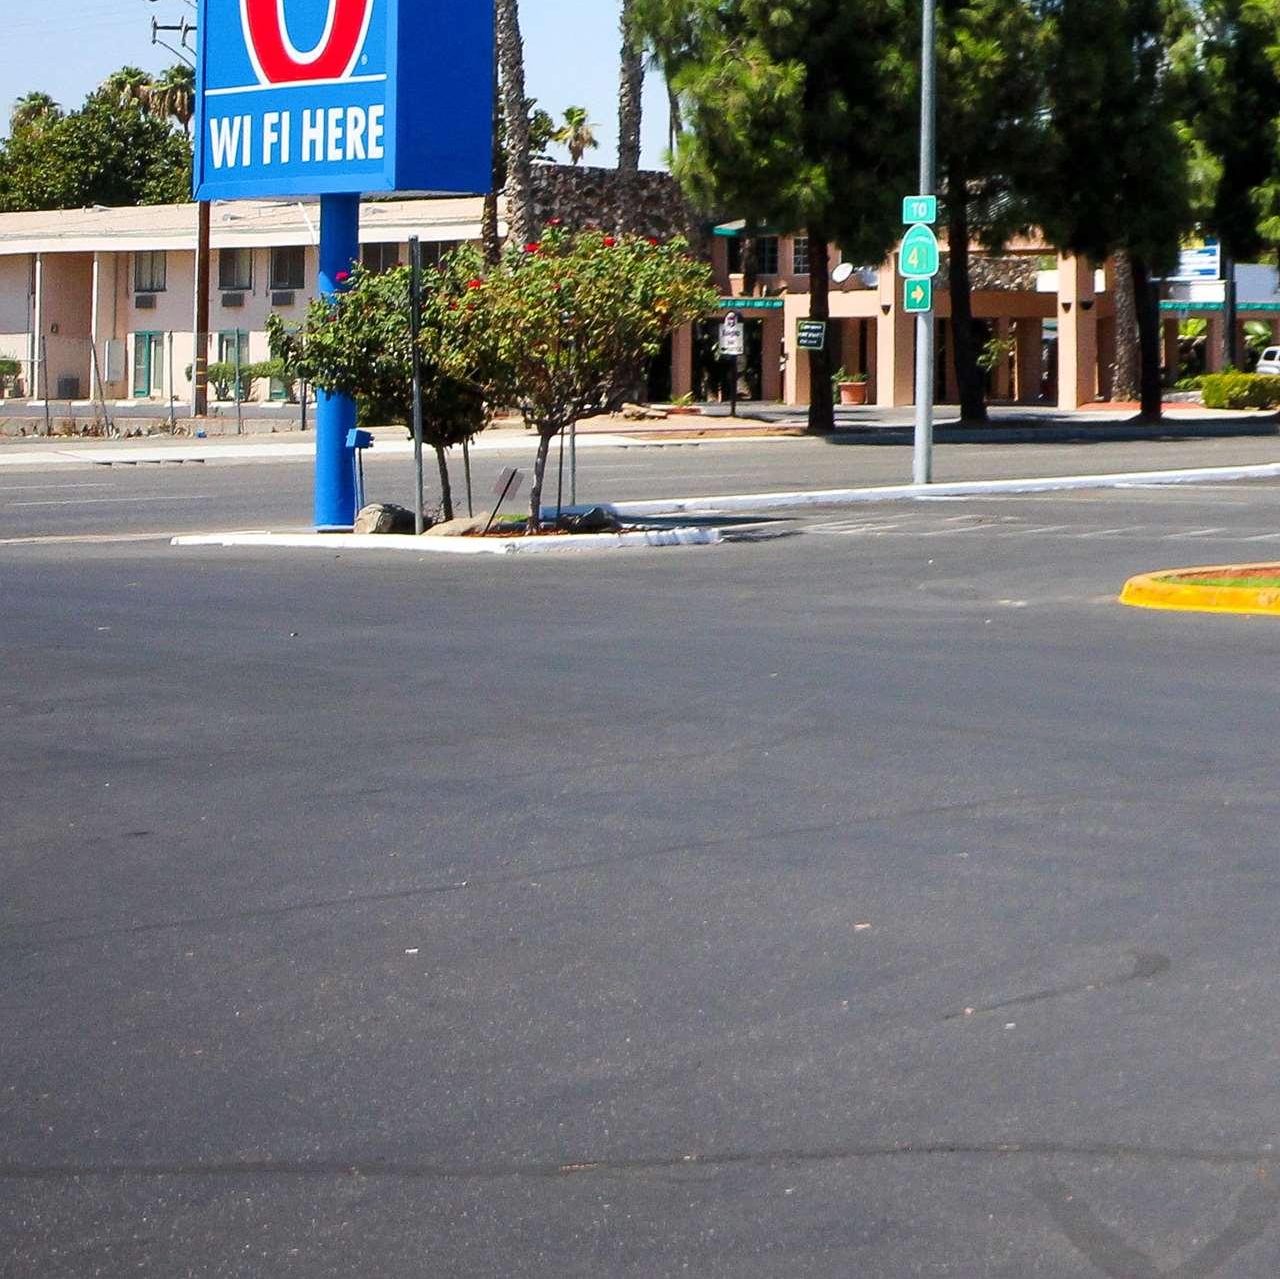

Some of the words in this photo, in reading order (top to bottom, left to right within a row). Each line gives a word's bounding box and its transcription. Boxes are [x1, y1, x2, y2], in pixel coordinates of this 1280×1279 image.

[209, 115, 251, 169] WI
[263, 111, 290, 165] FI
[302, 104, 384, 162] HERE
[911, 202, 928, 218] TO
